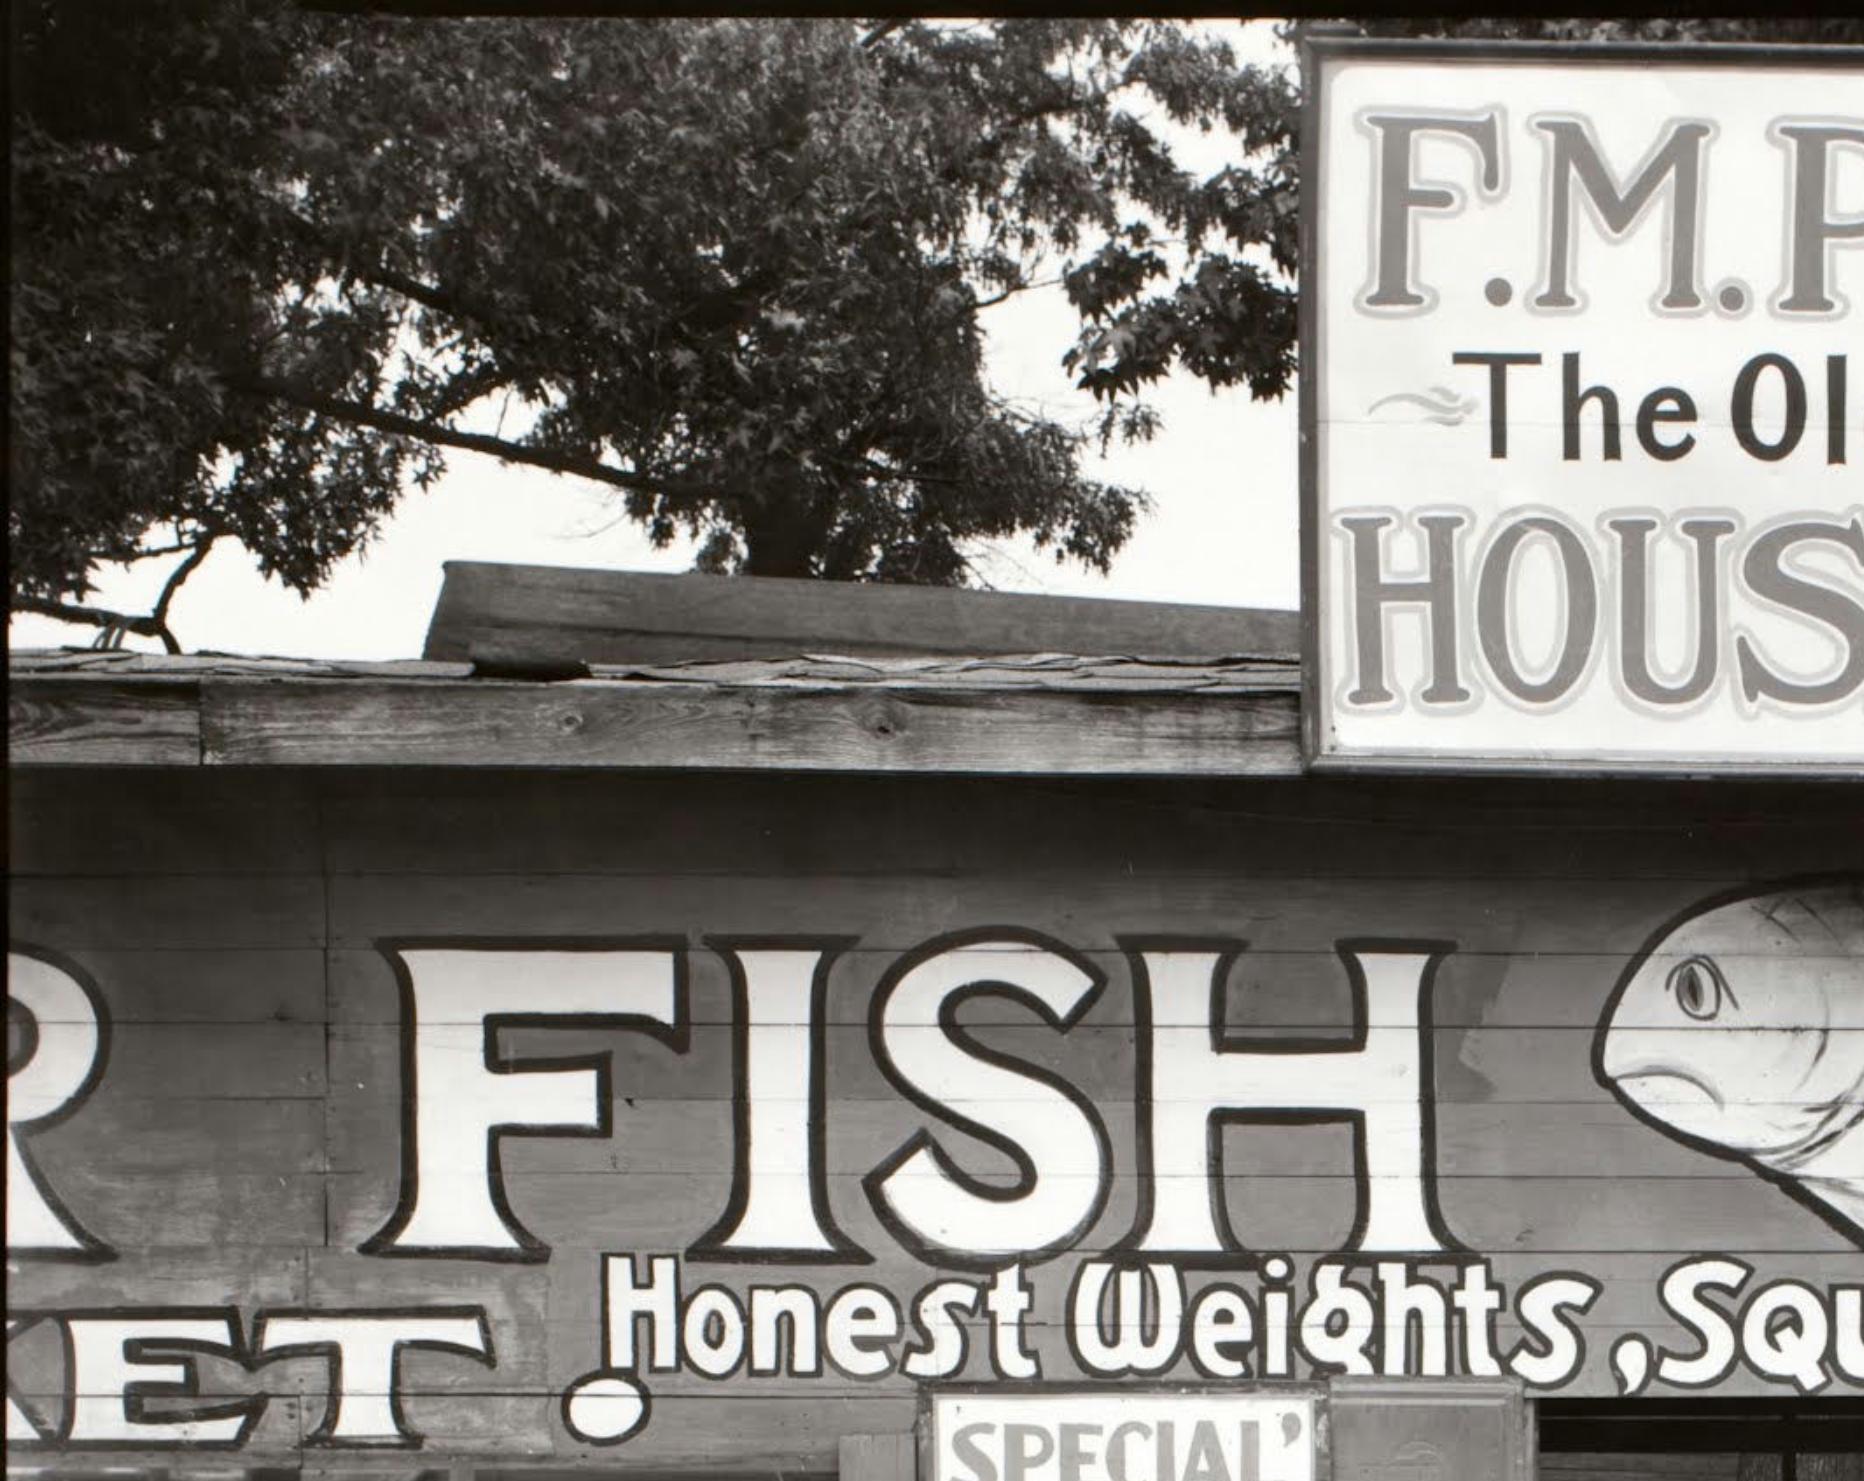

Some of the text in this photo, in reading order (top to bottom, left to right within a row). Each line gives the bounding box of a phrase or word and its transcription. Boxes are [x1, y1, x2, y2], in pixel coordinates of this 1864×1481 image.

[1453, 353, 1697, 463] The
[357, 925, 1481, 1270] FISH
[601, 1252, 1042, 1381] Honest
